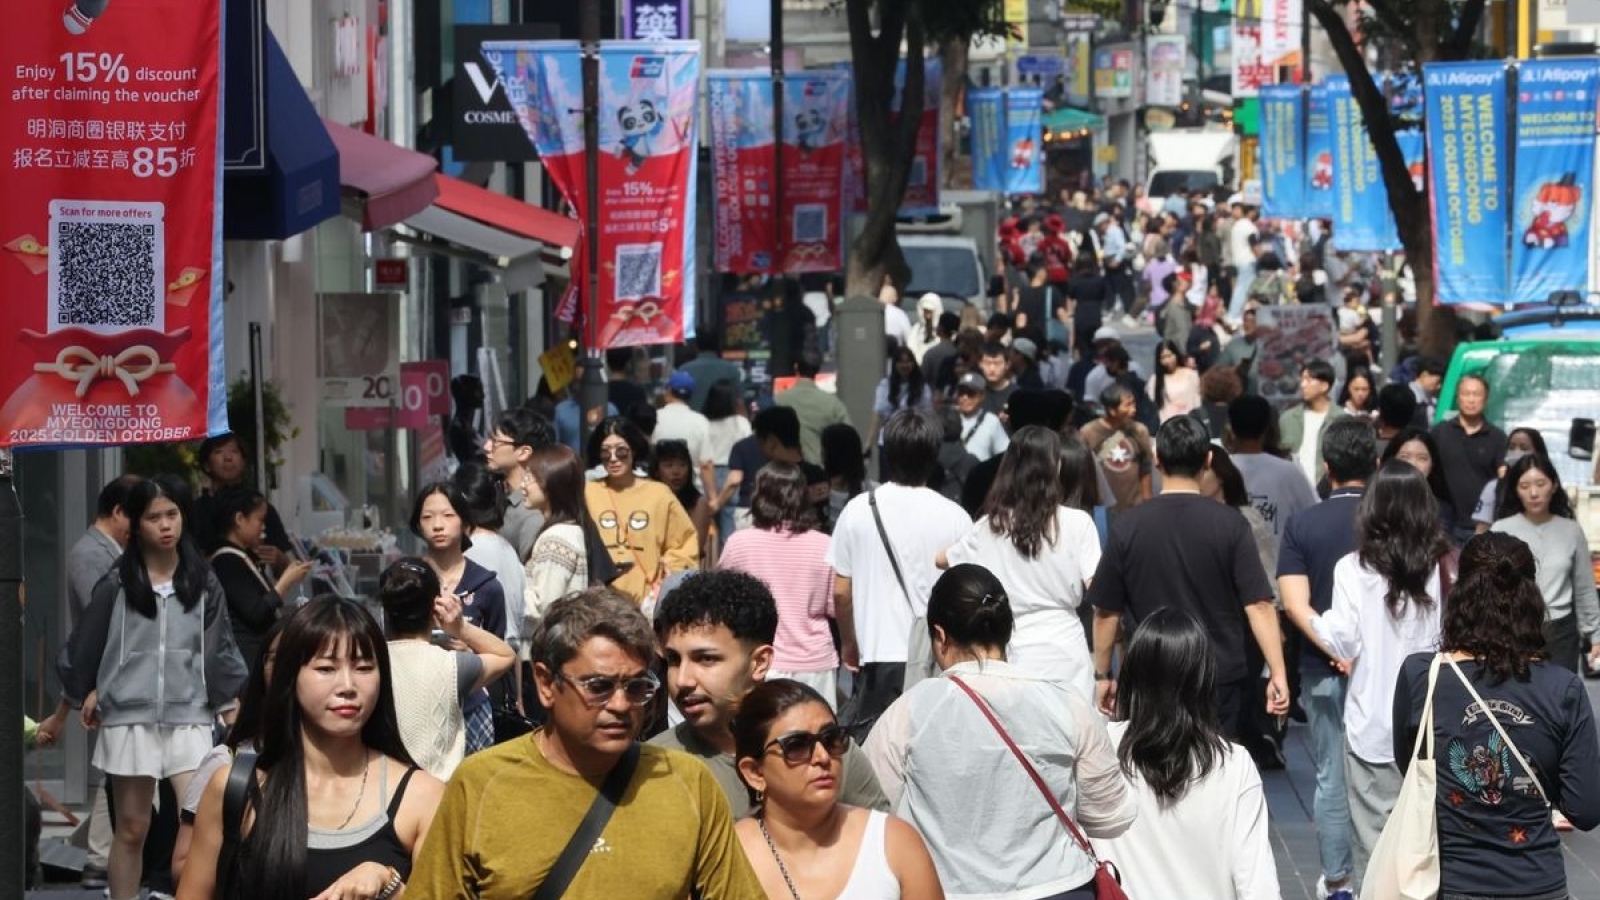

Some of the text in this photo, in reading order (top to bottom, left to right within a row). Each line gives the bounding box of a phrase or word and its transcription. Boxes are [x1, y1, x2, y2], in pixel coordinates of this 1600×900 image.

[16, 52, 197, 83] Enjoy 15% discount
[12, 86, 200, 104] after claiming the voucher
[27, 118, 187, 142] 明洞商圈银联支付
[1478, 93, 1499, 210] WELCOME TO
[13, 147, 197, 178] 报名立减至高85折
[1443, 134, 1461, 193] GOLDEN
[59, 206, 152, 218] Scan for more offers
[52, 405, 158, 418] WELCOME TO
[46, 417, 161, 430] MYEONGDONG
[10, 426, 192, 443] 2025 GOLDEN OCTOBER
